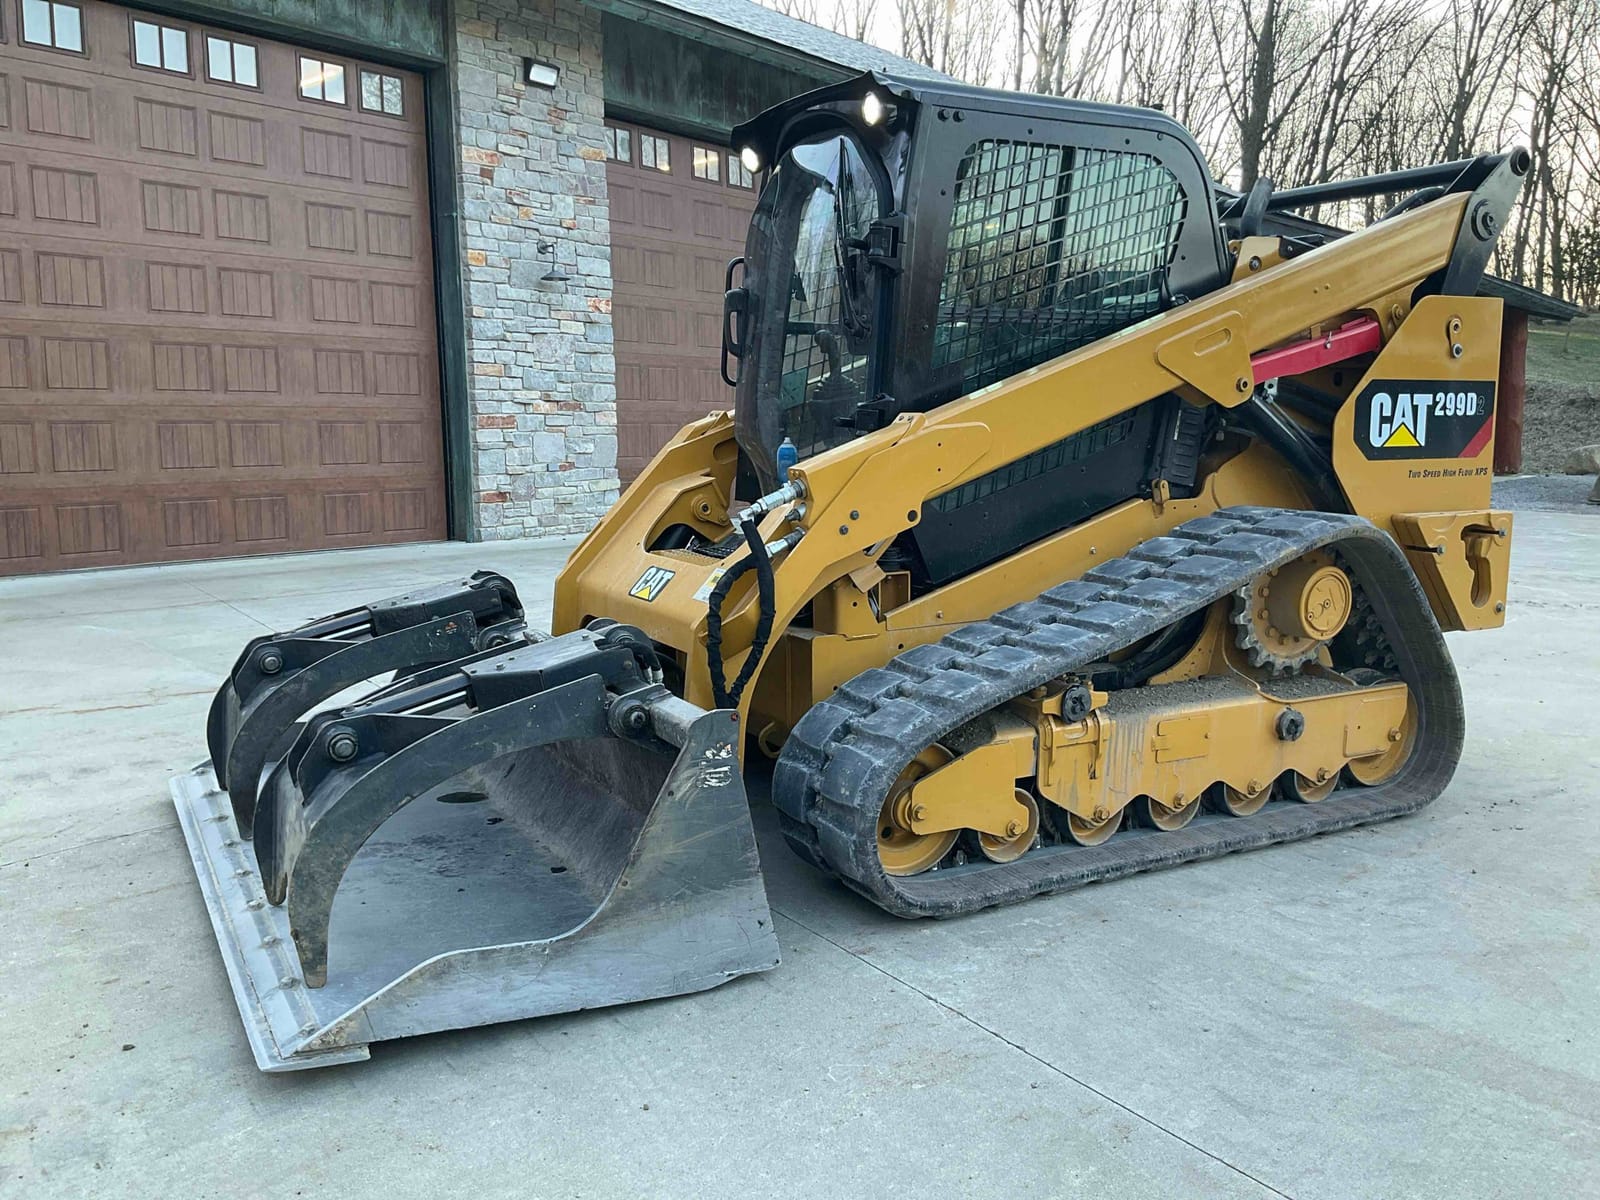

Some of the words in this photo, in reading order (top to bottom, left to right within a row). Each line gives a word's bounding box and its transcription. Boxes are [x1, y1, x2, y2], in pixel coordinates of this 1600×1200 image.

[1369, 392, 1433, 447] CAT
[1475, 467, 1489, 476] XPS
[630, 567, 675, 601] CAT
